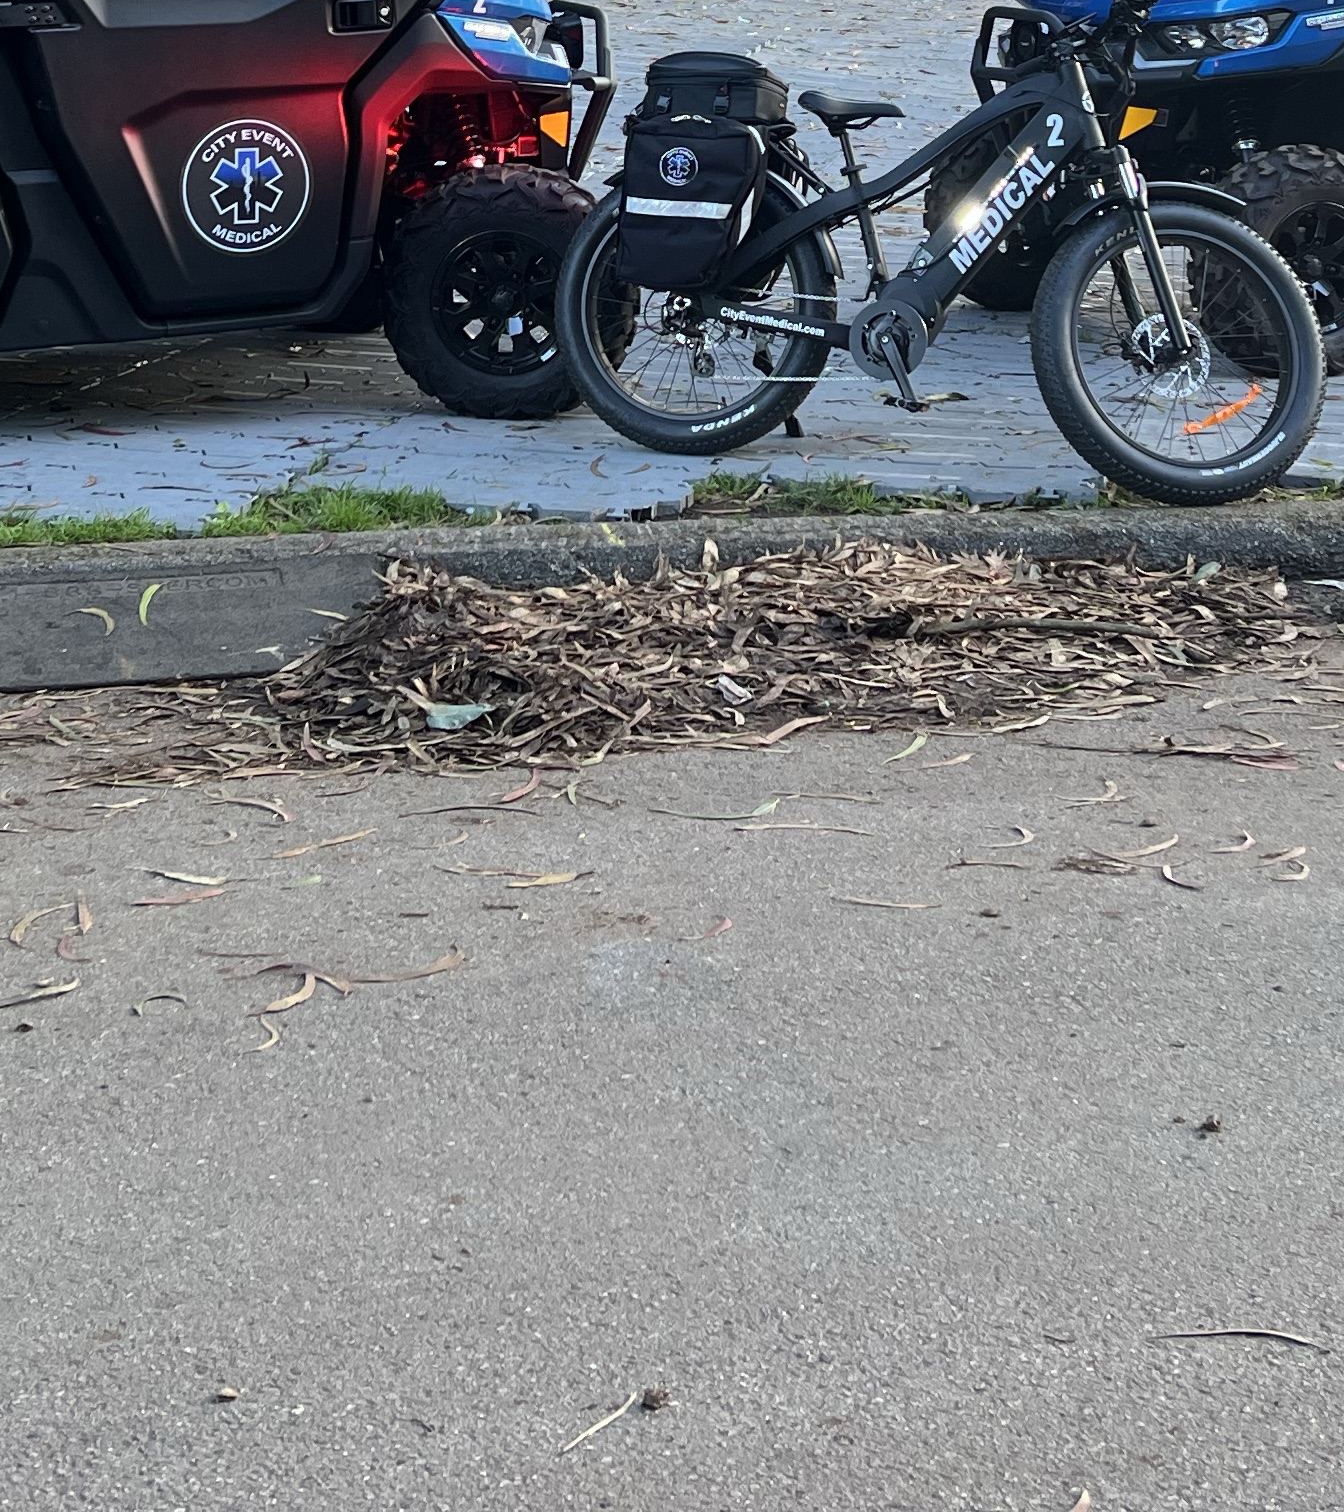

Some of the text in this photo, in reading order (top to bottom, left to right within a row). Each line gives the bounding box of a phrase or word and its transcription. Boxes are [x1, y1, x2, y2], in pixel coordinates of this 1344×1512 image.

[1046, 113, 1065, 147] 2
[202, 129, 294, 163] CITY EVENT
[949, 154, 1056, 275] MEDICAL
[212, 224, 282, 243] MEDICAL
[1094, 226, 1135, 257] KEN
[720, 306, 825, 337] CityEventMedical.com
[691, 404, 755, 433] KENDA
